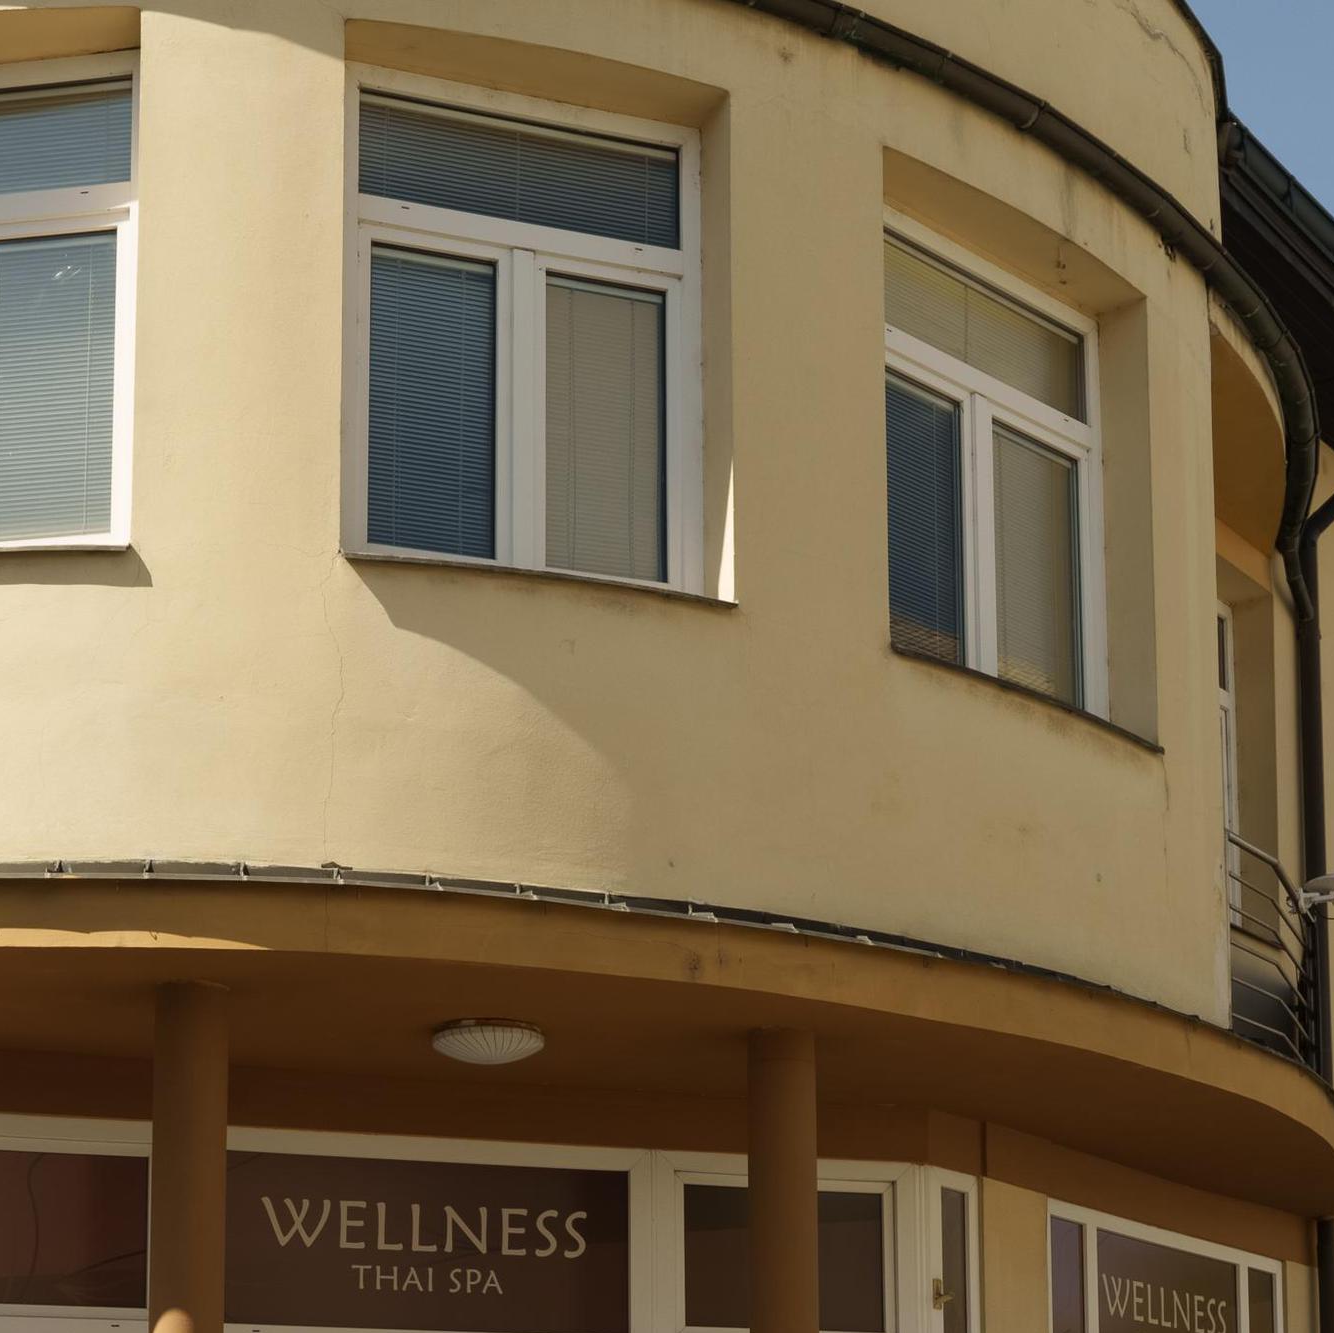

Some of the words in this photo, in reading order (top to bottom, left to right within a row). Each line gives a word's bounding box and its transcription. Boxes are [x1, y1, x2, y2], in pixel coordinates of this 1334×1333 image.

[261, 1196, 587, 1259] WELLNESS
[351, 1264, 434, 1293] THAI
[449, 1268, 503, 1295] SPA
